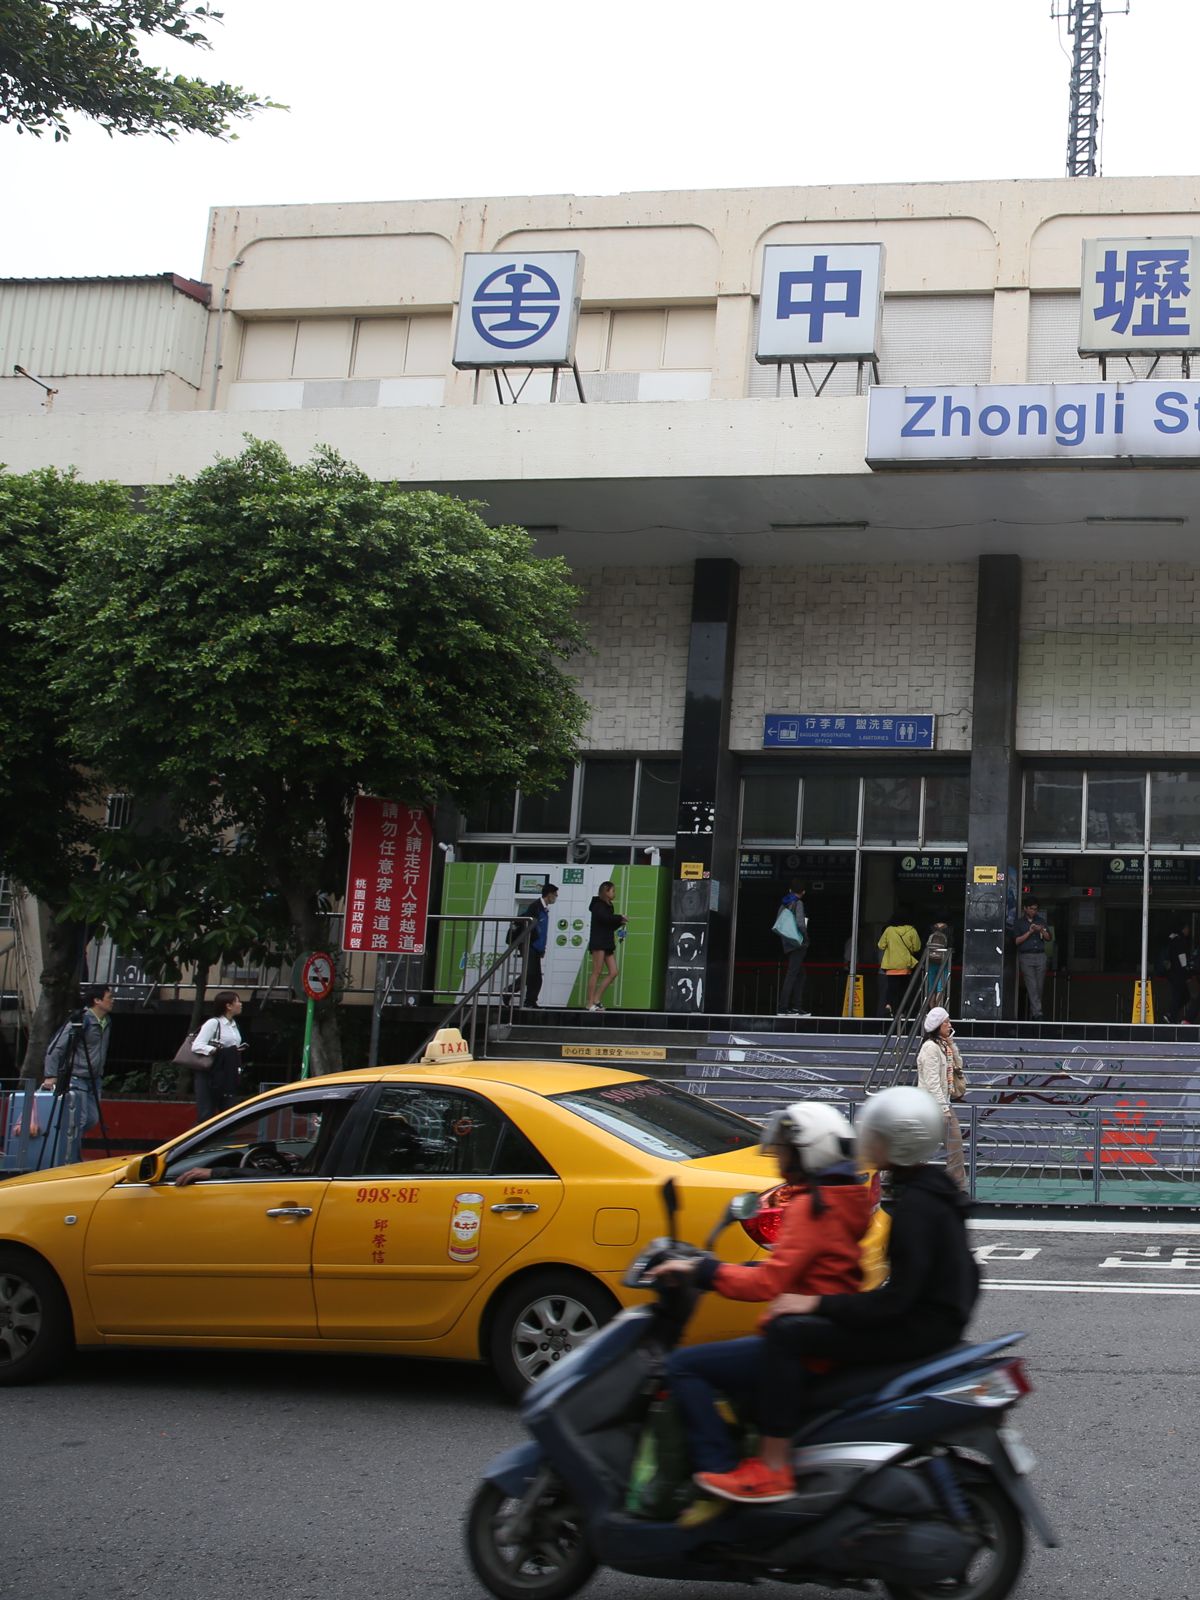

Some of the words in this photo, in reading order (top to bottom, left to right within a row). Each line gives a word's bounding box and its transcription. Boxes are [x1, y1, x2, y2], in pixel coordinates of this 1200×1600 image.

[776, 254, 863, 343] 中
[1093, 249, 1190, 337] 壢
[900, 391, 1125, 446] Zhongli
[805, 718, 846, 730] 行李房
[855, 718, 894, 730] 盥洗室
[371, 802, 398, 949] 請勿任意穿越道路
[352, 878, 367, 934] 桃園市政府
[440, 1043, 468, 1055] TAXI
[356, 1187, 420, 1204] 998-8E
